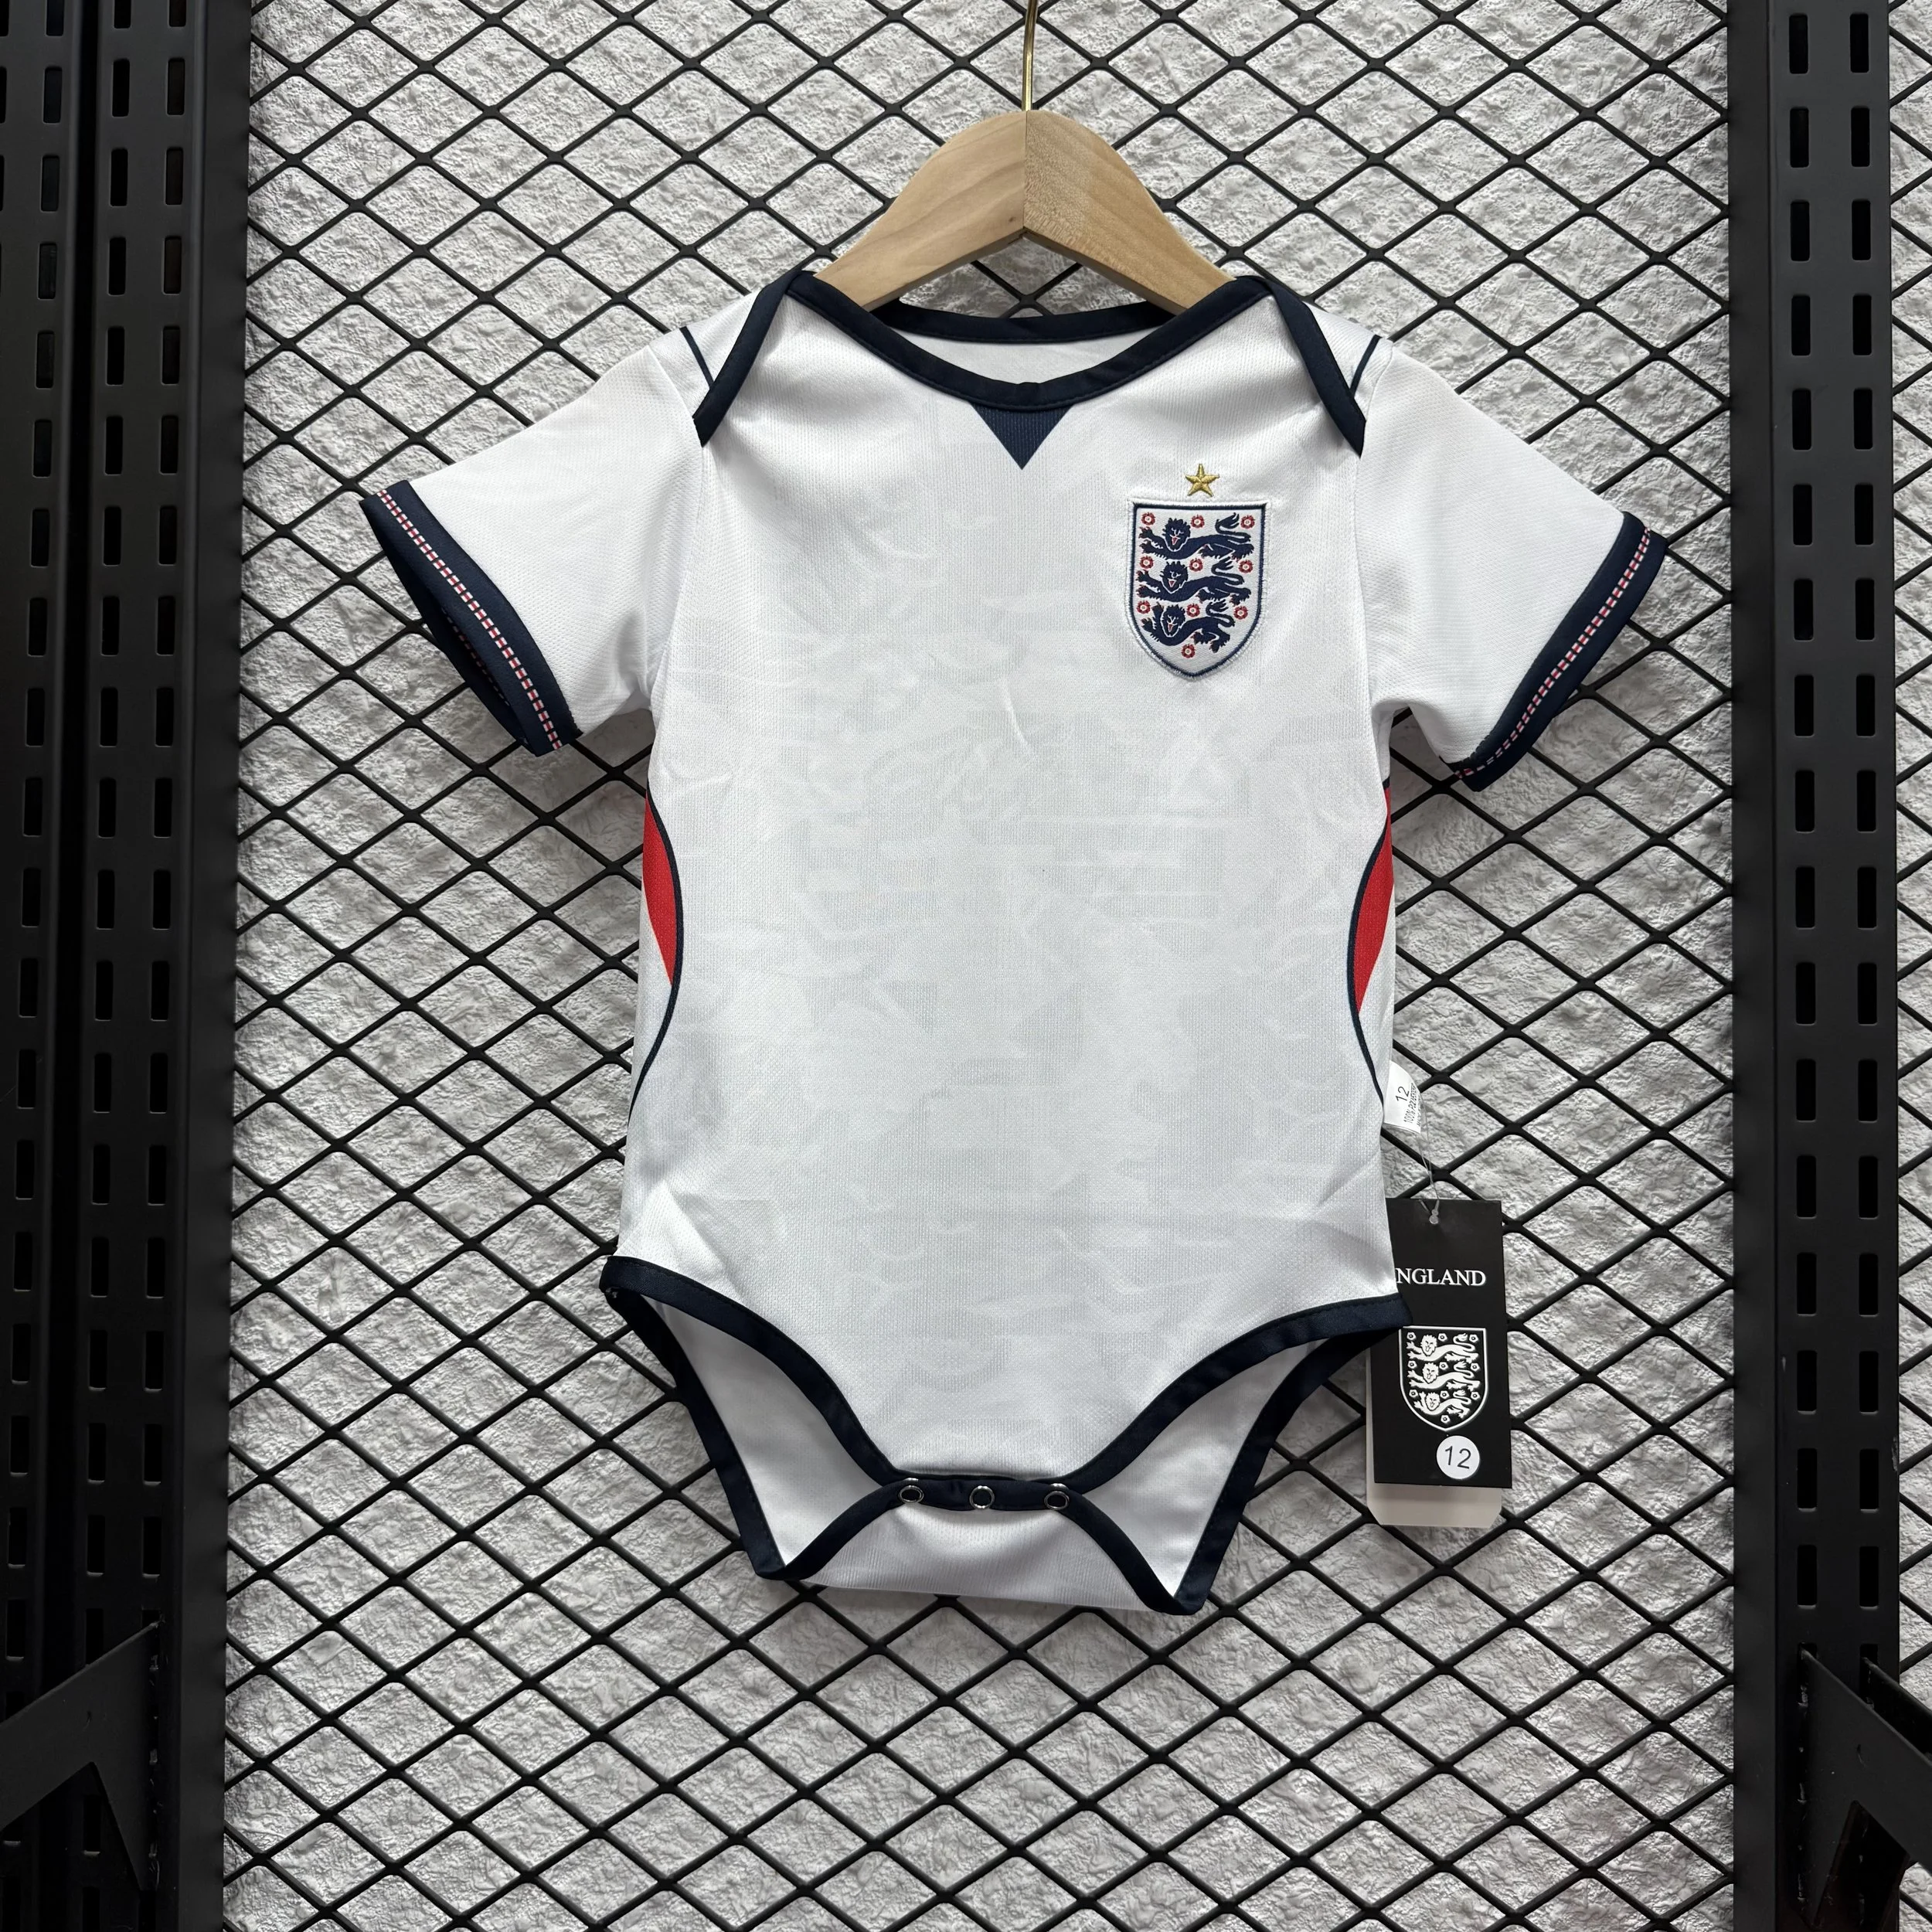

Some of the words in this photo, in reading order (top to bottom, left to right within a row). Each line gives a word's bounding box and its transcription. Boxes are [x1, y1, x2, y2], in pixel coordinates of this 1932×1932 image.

[1396, 1086, 1409, 1101] 12
[1395, 1267, 1486, 1286] NGLAND
[1445, 1445, 1471, 1469] 12
